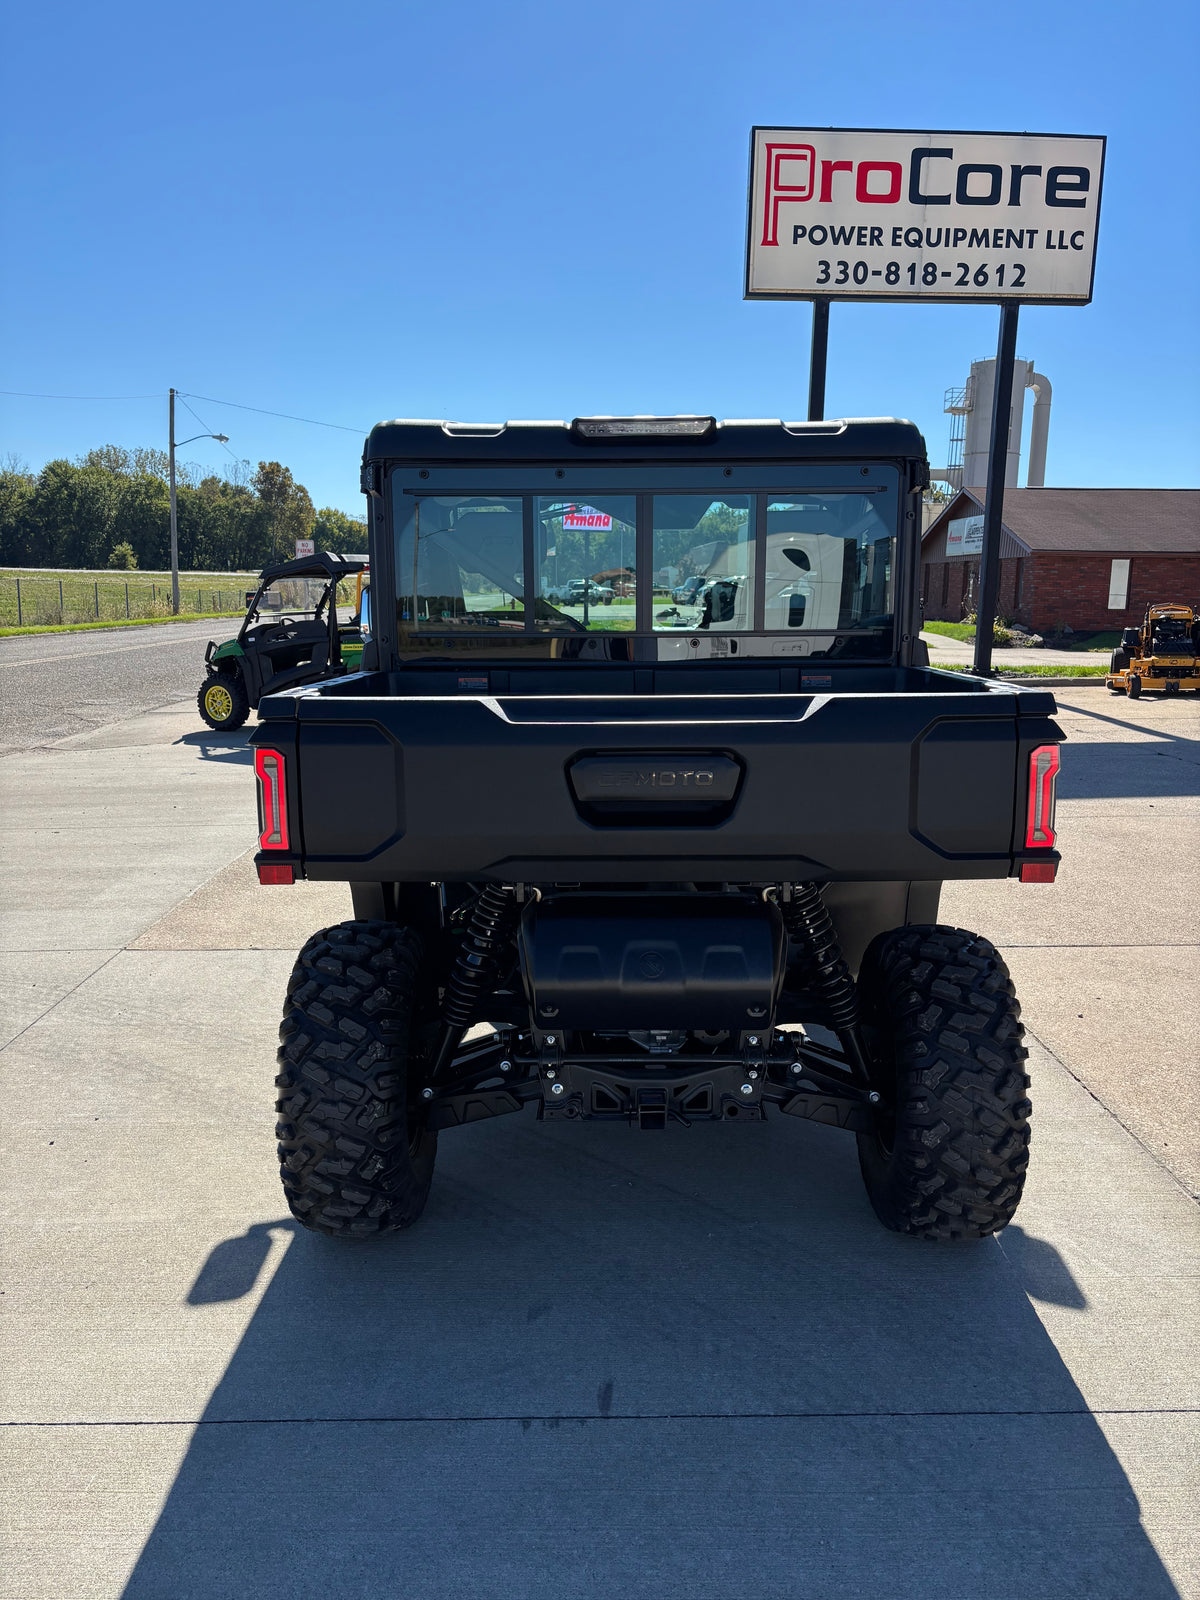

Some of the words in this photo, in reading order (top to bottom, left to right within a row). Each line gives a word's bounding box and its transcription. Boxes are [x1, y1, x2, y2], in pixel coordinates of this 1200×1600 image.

[761, 143, 1091, 246] ProCore
[792, 224, 884, 247] POWER
[891, 226, 1039, 250] EQUIPMENT
[1045, 229, 1085, 251] LLC
[815, 259, 1027, 288] 330-818-2612
[564, 509, 611, 527] Amana
[599, 771, 714, 786] CFMOTO
